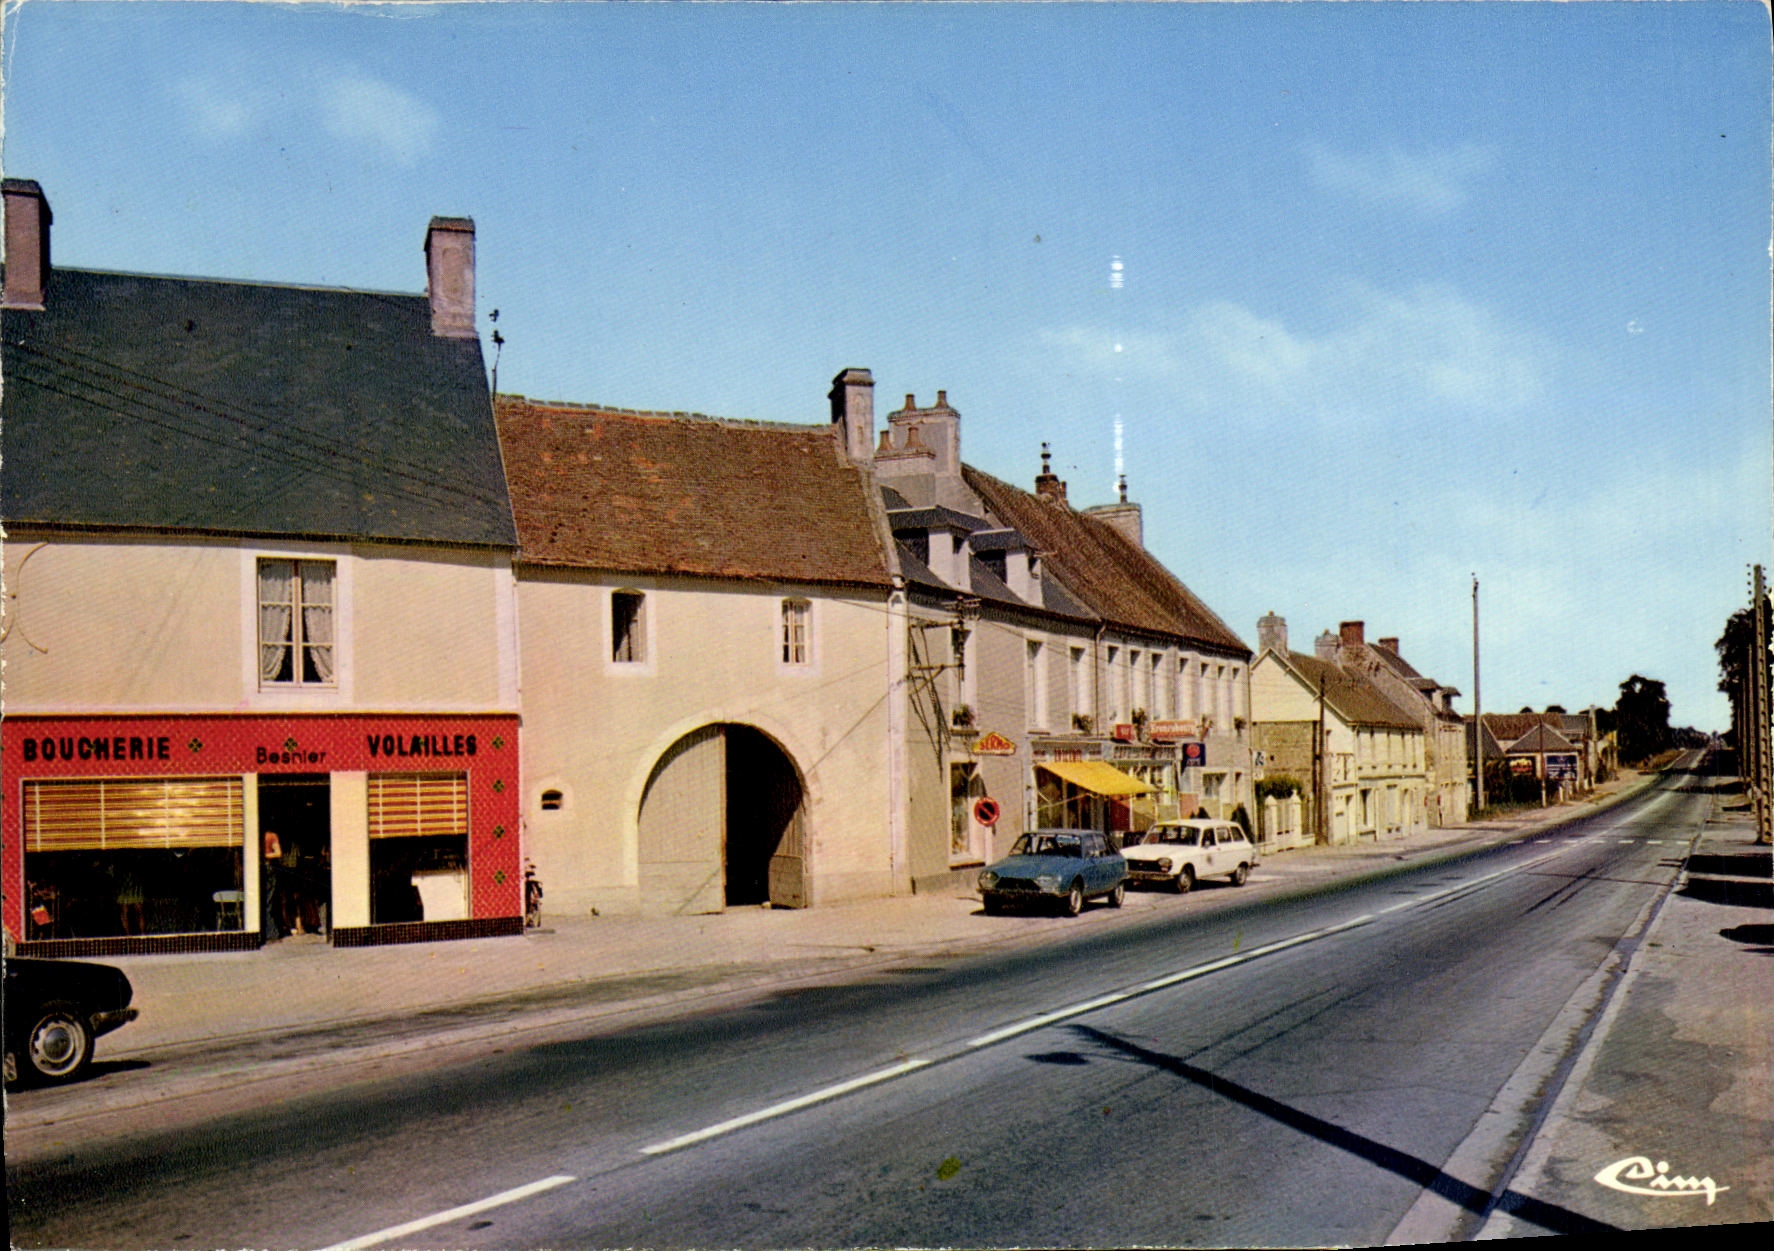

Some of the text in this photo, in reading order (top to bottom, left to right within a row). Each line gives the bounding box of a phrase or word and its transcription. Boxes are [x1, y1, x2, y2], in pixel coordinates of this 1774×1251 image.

[23, 737, 170, 761] BOUCHERIE
[256, 747, 326, 764] Besnier
[367, 735, 477, 757] VOLAILLES
